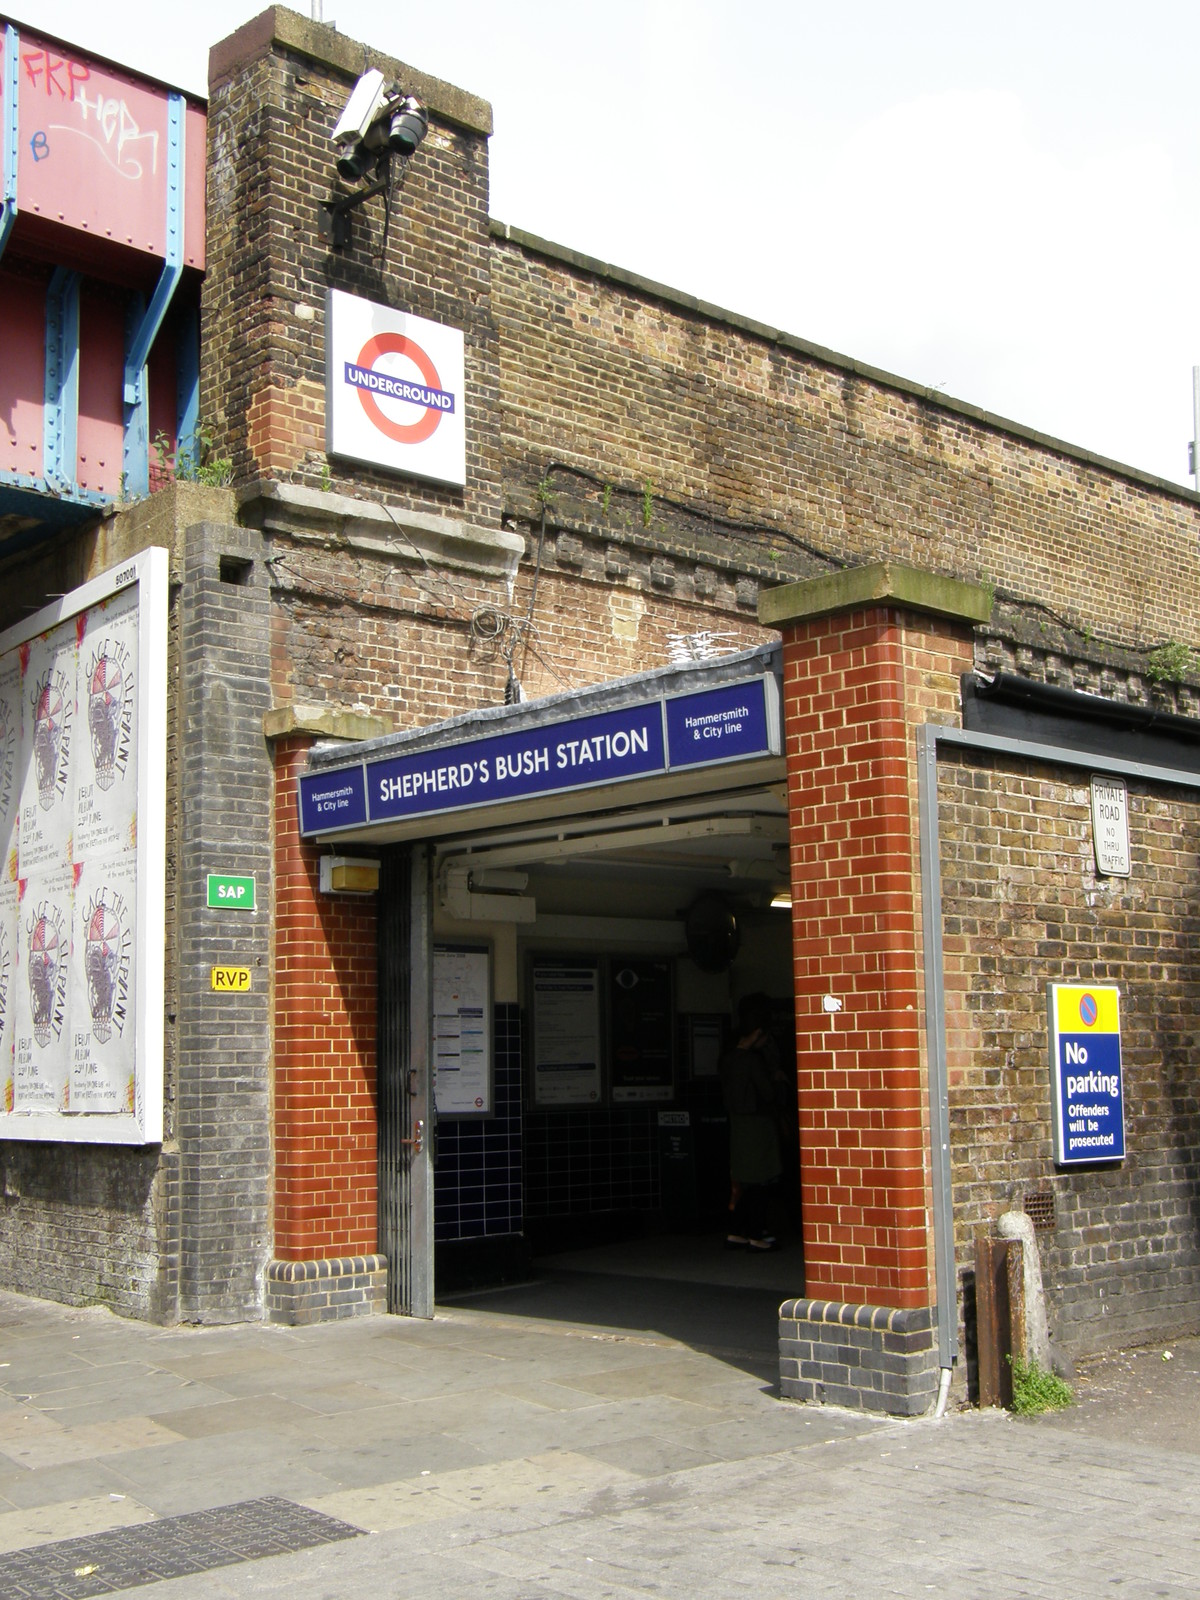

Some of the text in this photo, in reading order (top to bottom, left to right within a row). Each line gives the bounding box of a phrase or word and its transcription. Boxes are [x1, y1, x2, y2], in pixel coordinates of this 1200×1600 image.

[348, 367, 452, 409] UNDERGROUND
[114, 641, 130, 669] THE
[57, 670, 70, 697] THE
[115, 672, 134, 781] ELEPHANT
[685, 706, 749, 728] Hammersmith
[693, 723, 742, 740] & City line
[56, 700, 73, 801] ELEPHANT
[380, 727, 649, 802] SHEPHERD'S BUSH STATION
[312, 786, 354, 803] Hammersmith
[1094, 784, 1124, 803] PRIVATE
[317, 799, 349, 812] & City line
[1099, 804, 1120, 821] ROAD
[1106, 828, 1115, 838] NO
[1104, 840, 1120, 852] THRU
[1101, 854, 1124, 866] TRAFFIC
[218, 885, 245, 899] SAP
[112, 891, 129, 924] THE
[53, 904, 66, 935] THE
[112, 928, 132, 1039] ELEPHANT
[216, 971, 248, 986] RVP
[51, 939, 69, 1043] ELEPHANT
[1065, 1042, 1088, 1064] No
[1066, 1071, 1119, 1099] parking
[1068, 1104, 1109, 1117] Offenders
[1069, 1119, 1098, 1132] will be
[1069, 1133, 1114, 1150] prosecuted
